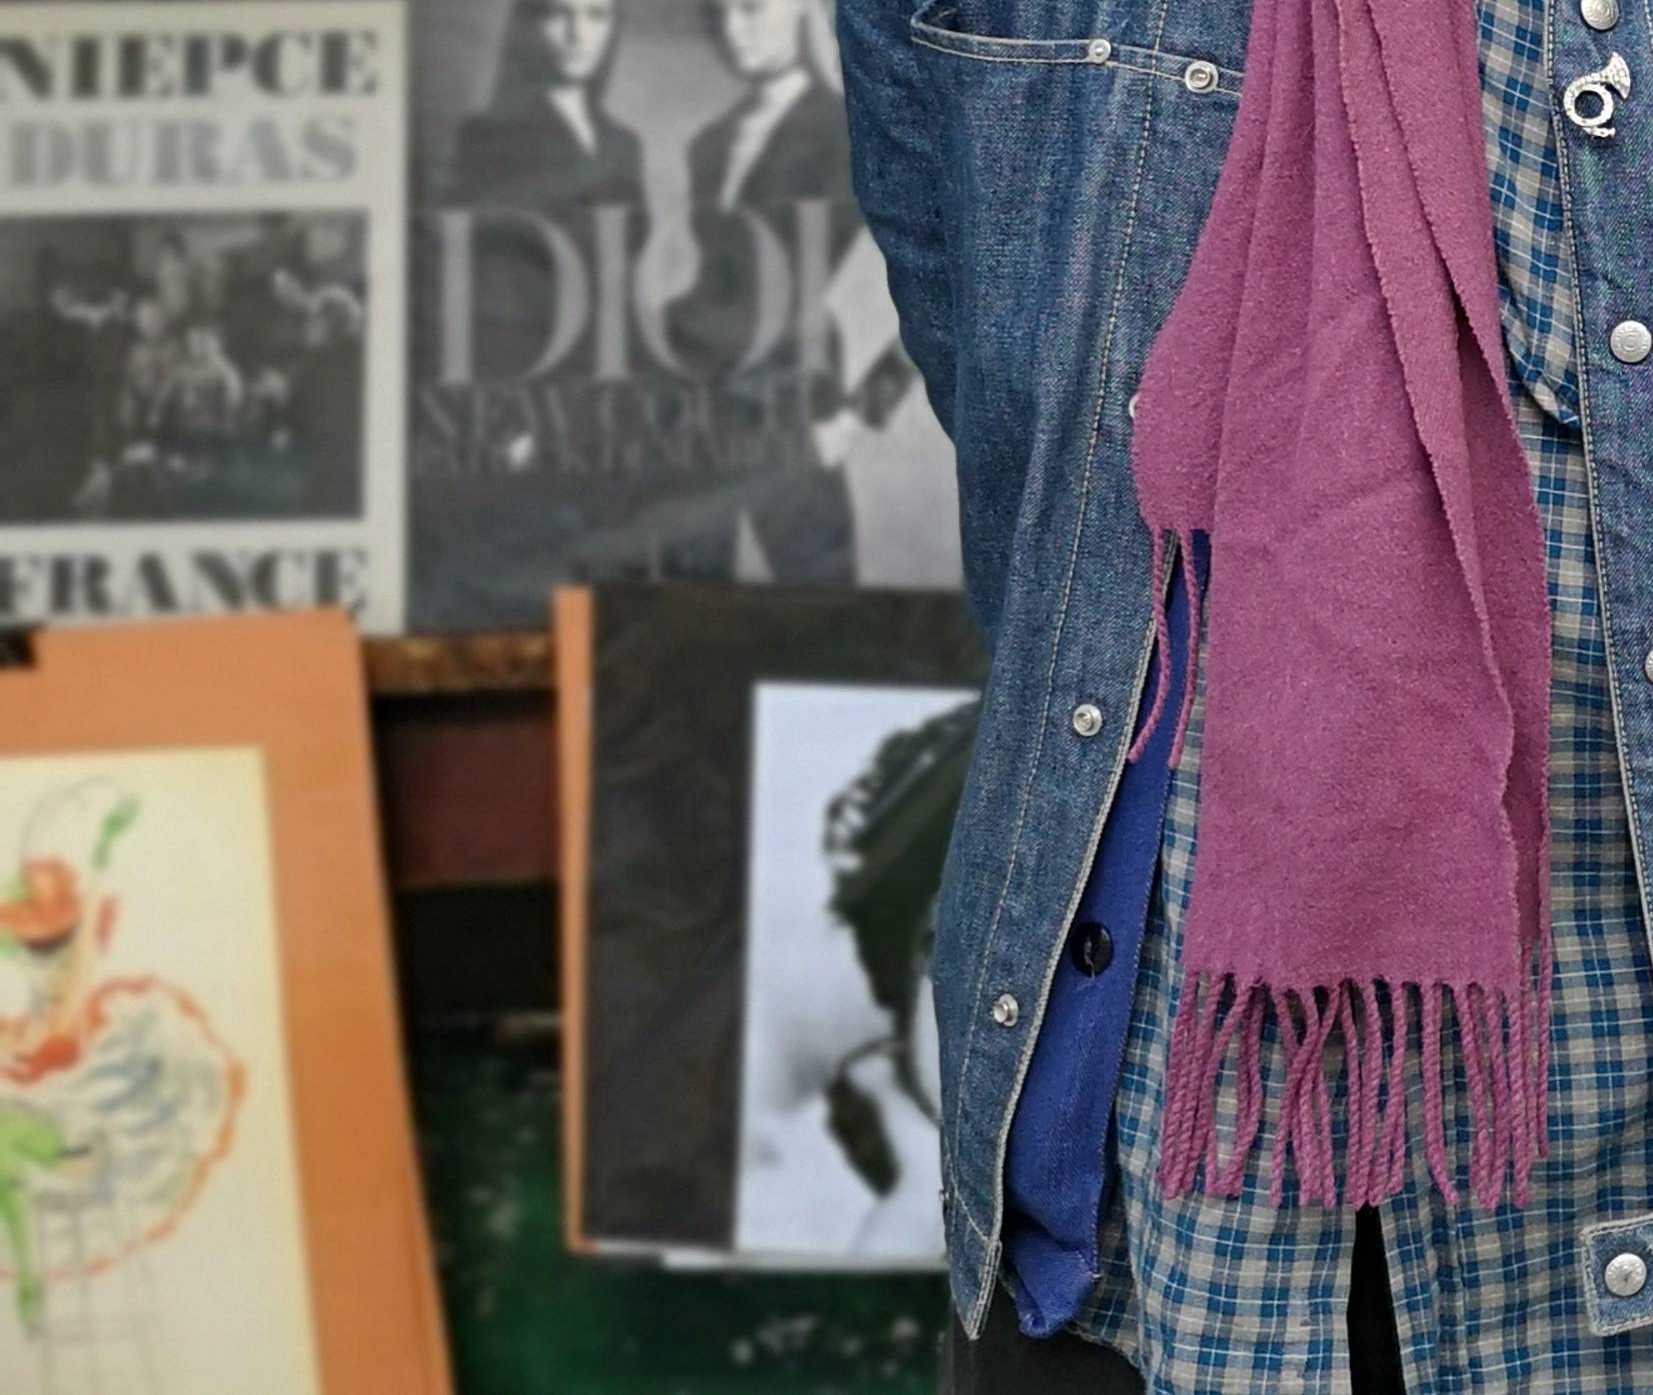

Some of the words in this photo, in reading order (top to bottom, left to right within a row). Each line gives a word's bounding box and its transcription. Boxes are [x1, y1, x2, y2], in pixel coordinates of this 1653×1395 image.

[0, 29, 379, 103] NIEPCE
[9, 114, 359, 188] DURAS
[0, 547, 366, 617] FRANCE
